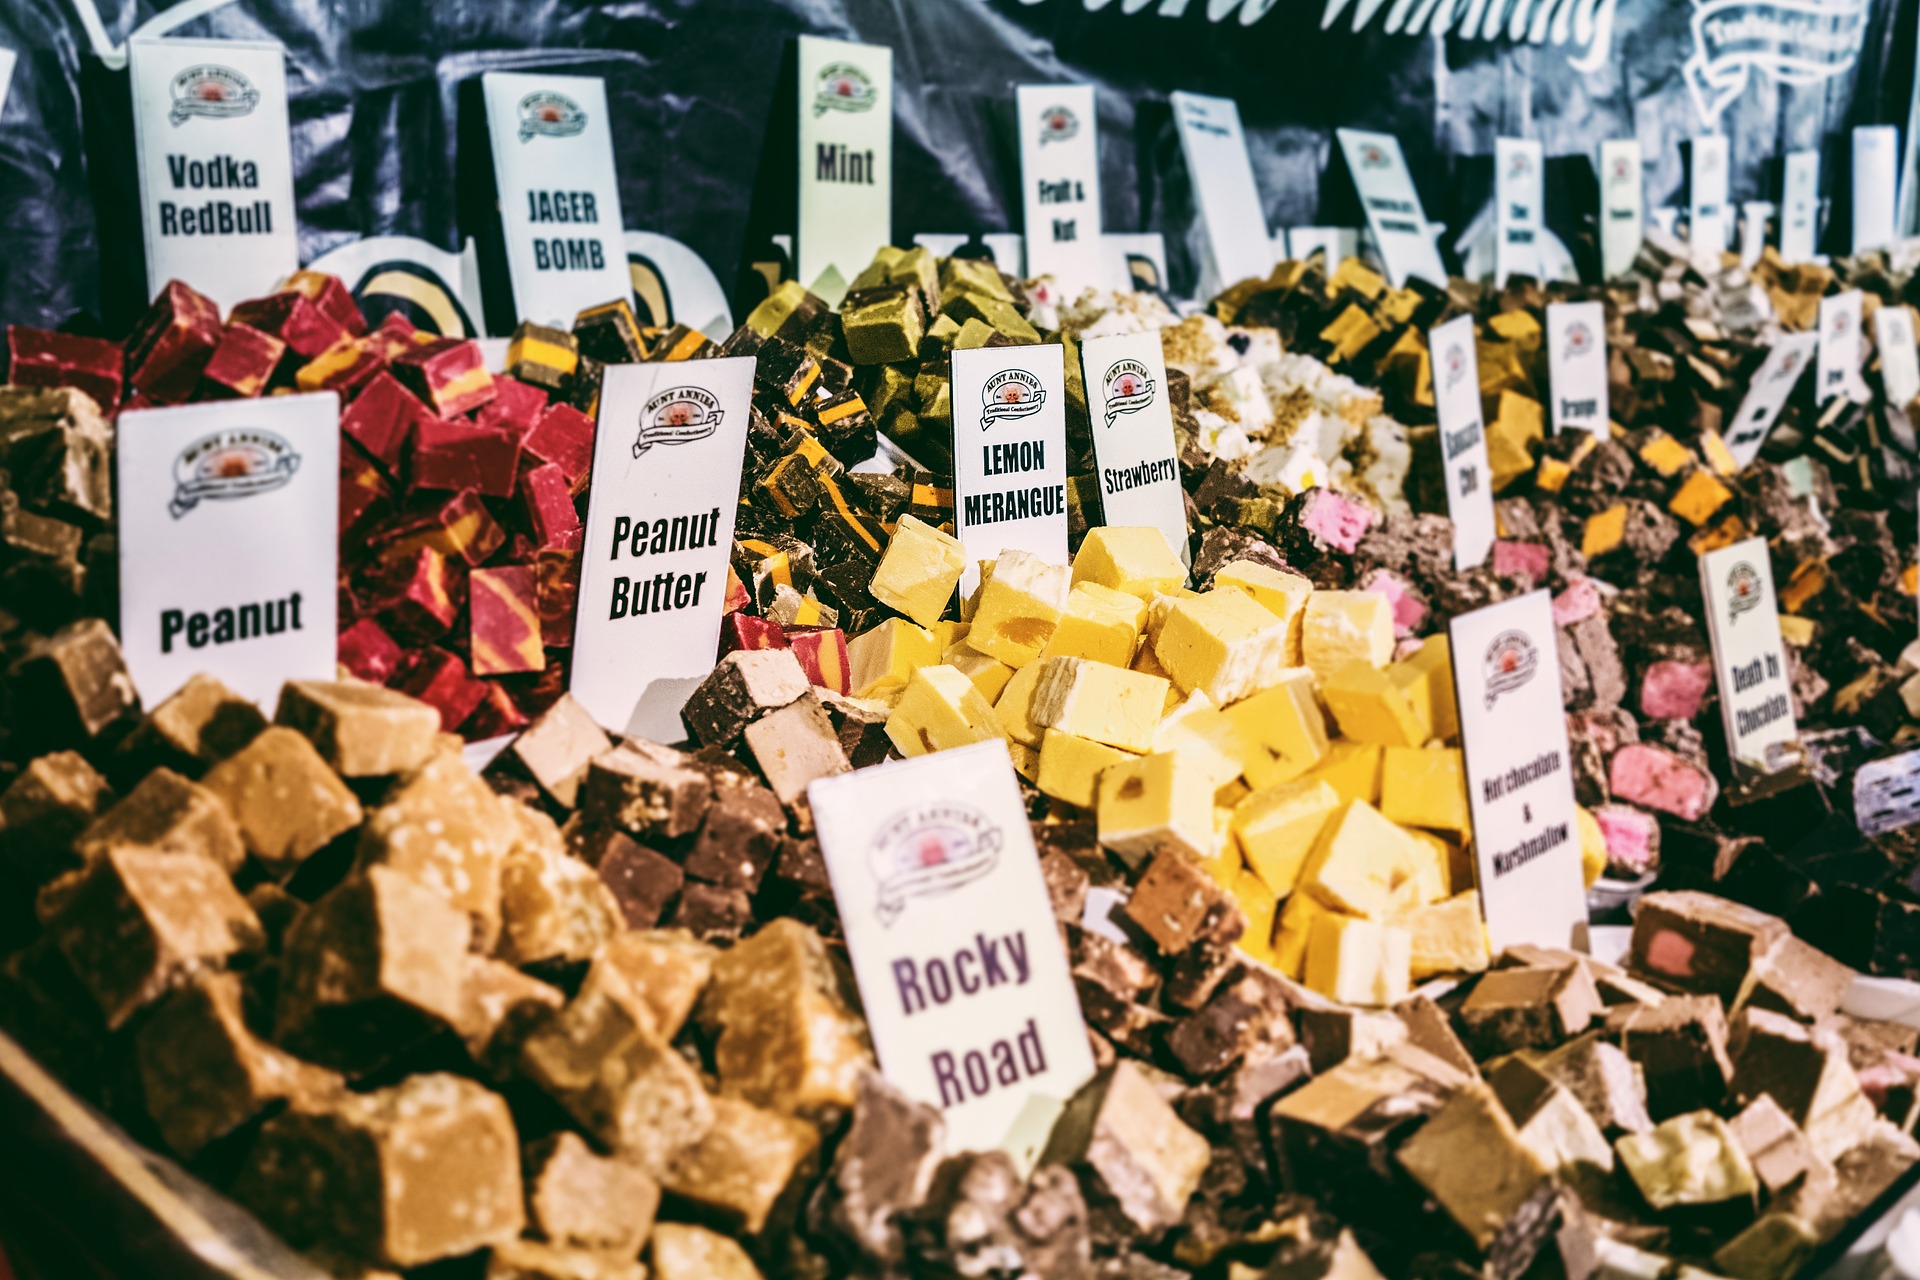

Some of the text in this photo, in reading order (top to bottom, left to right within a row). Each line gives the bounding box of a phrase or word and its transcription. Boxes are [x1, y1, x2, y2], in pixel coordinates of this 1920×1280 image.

[166, 153, 259, 190] Vodka
[815, 142, 875, 185] Mint
[527, 190, 599, 224] JAGER
[1038, 179, 1072, 204] Fruit
[158, 200, 273, 237] RedBull
[532, 238, 606, 271] BOMB
[647, 389, 715, 414] AUNT ANNIES
[986, 372, 1038, 394] AUNT ANNIES
[983, 440, 1045, 476] LEMON
[1104, 457, 1176, 495] Strawberry
[964, 485, 1065, 527] MERANGUE
[610, 507, 721, 561] Peanut
[608, 571, 707, 621] Butter
[159, 591, 303, 655] Peanut
[1731, 654, 1780, 694] Death by
[1736, 694, 1789, 738] Chocolate
[1504, 751, 1561, 794] chocolate
[1491, 821, 1570, 879] Marshmallow
[890, 931, 1032, 1017] Rocky
[929, 1018, 1048, 1109] Road
